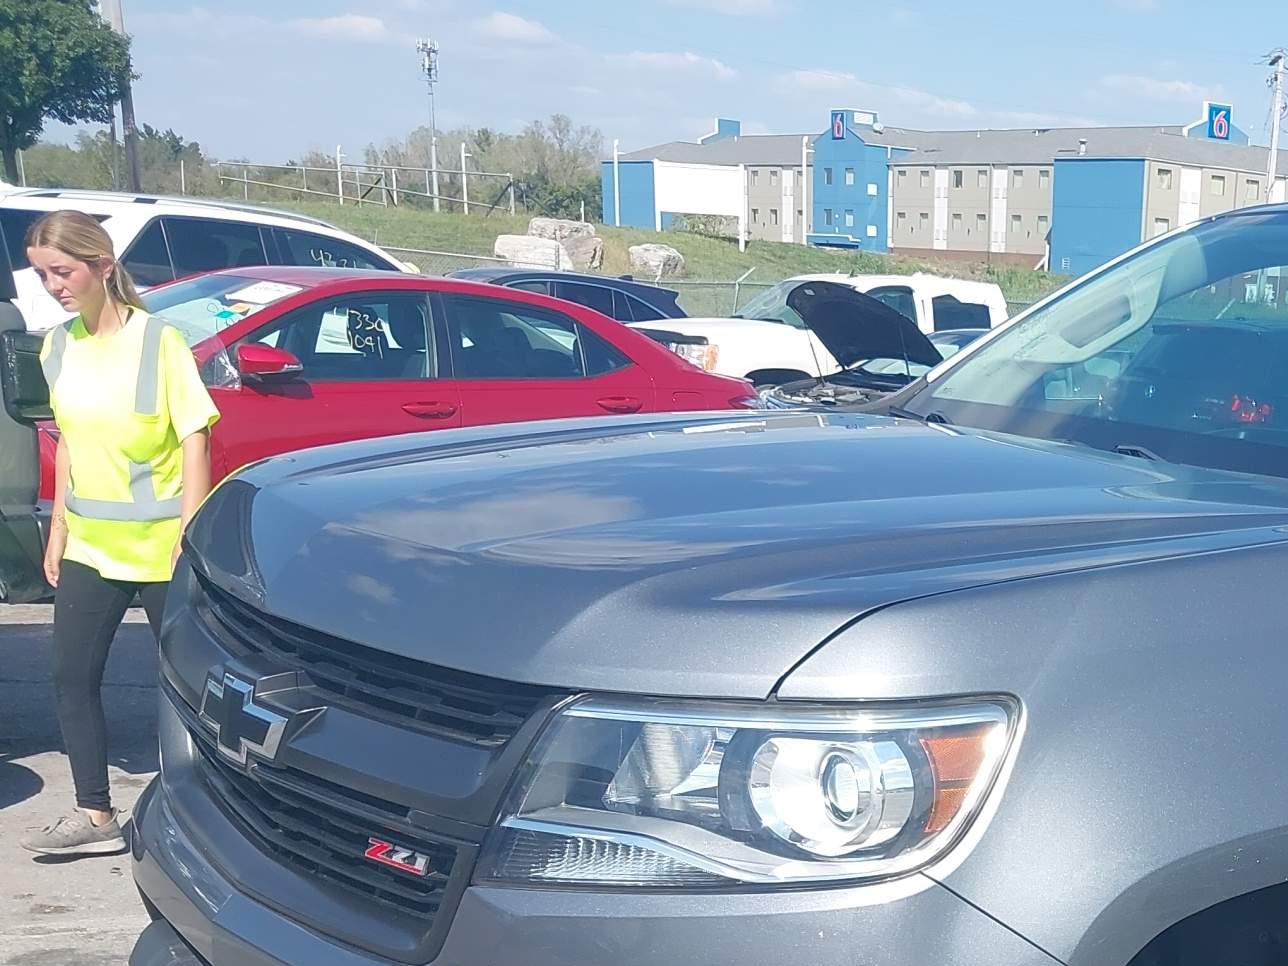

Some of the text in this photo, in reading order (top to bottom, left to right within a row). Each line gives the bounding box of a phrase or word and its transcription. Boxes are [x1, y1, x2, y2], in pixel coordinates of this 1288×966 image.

[833, 113, 843, 138] 6
[1213, 110, 1229, 138] 6
[364, 837, 431, 876] Z71
